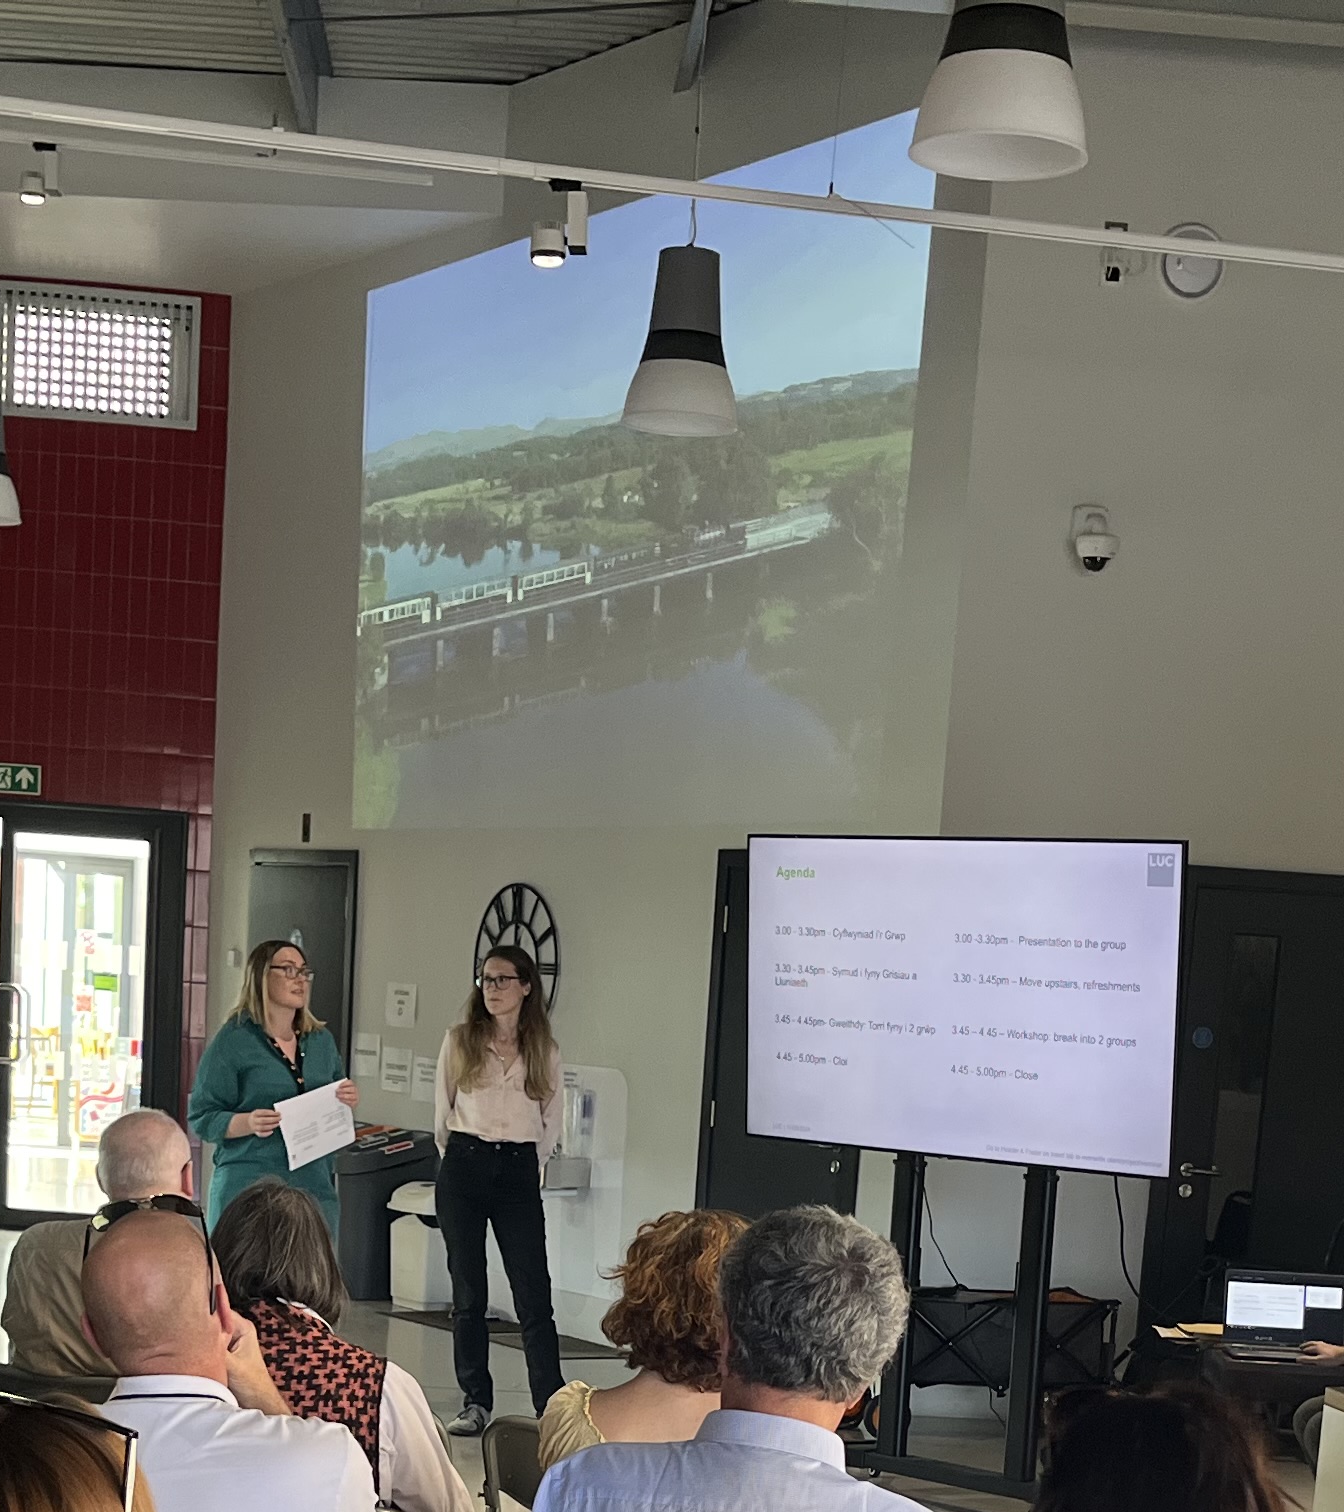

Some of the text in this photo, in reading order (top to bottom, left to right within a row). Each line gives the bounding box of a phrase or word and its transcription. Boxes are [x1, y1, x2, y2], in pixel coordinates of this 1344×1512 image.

[1149, 854, 1174, 867] LUC
[775, 865, 816, 881] Agenda
[774, 925, 792, 936] 3.00
[798, 927, 826, 938] 3.30pm
[954, 933, 973, 944] 3.00
[1018, 935, 1072, 948] Presentation
[1073, 938, 1083, 948] to
[1084, 939, 1099, 949] the
[1100, 940, 1127, 951] group
[774, 963, 792, 974] 3.30
[797, 964, 826, 977] 3.45pm
[952, 973, 972, 984] 3.30
[978, 975, 1010, 988] 3.45pm
[1018, 976, 1043, 988] Move
[1044, 978, 1082, 991] upstairs,
[1082, 980, 1142, 993] refreshments
[774, 1013, 791, 1025] 3.45
[951, 1025, 970, 1037] 3.45
[978, 1027, 998, 1038] 4.45
[1053, 1031, 1078, 1043] break
[1079, 1033, 1096, 1045] into
[1098, 1034, 1105, 1045] 2
[1106, 1036, 1137, 1049] groups
[776, 1052, 793, 1062] 4.45
[798, 1053, 827, 1066] 5.00pm
[950, 1064, 969, 1075] 4.45
[975, 1066, 1007, 1079] 5.00pm
[1014, 1069, 1039, 1081] Close
